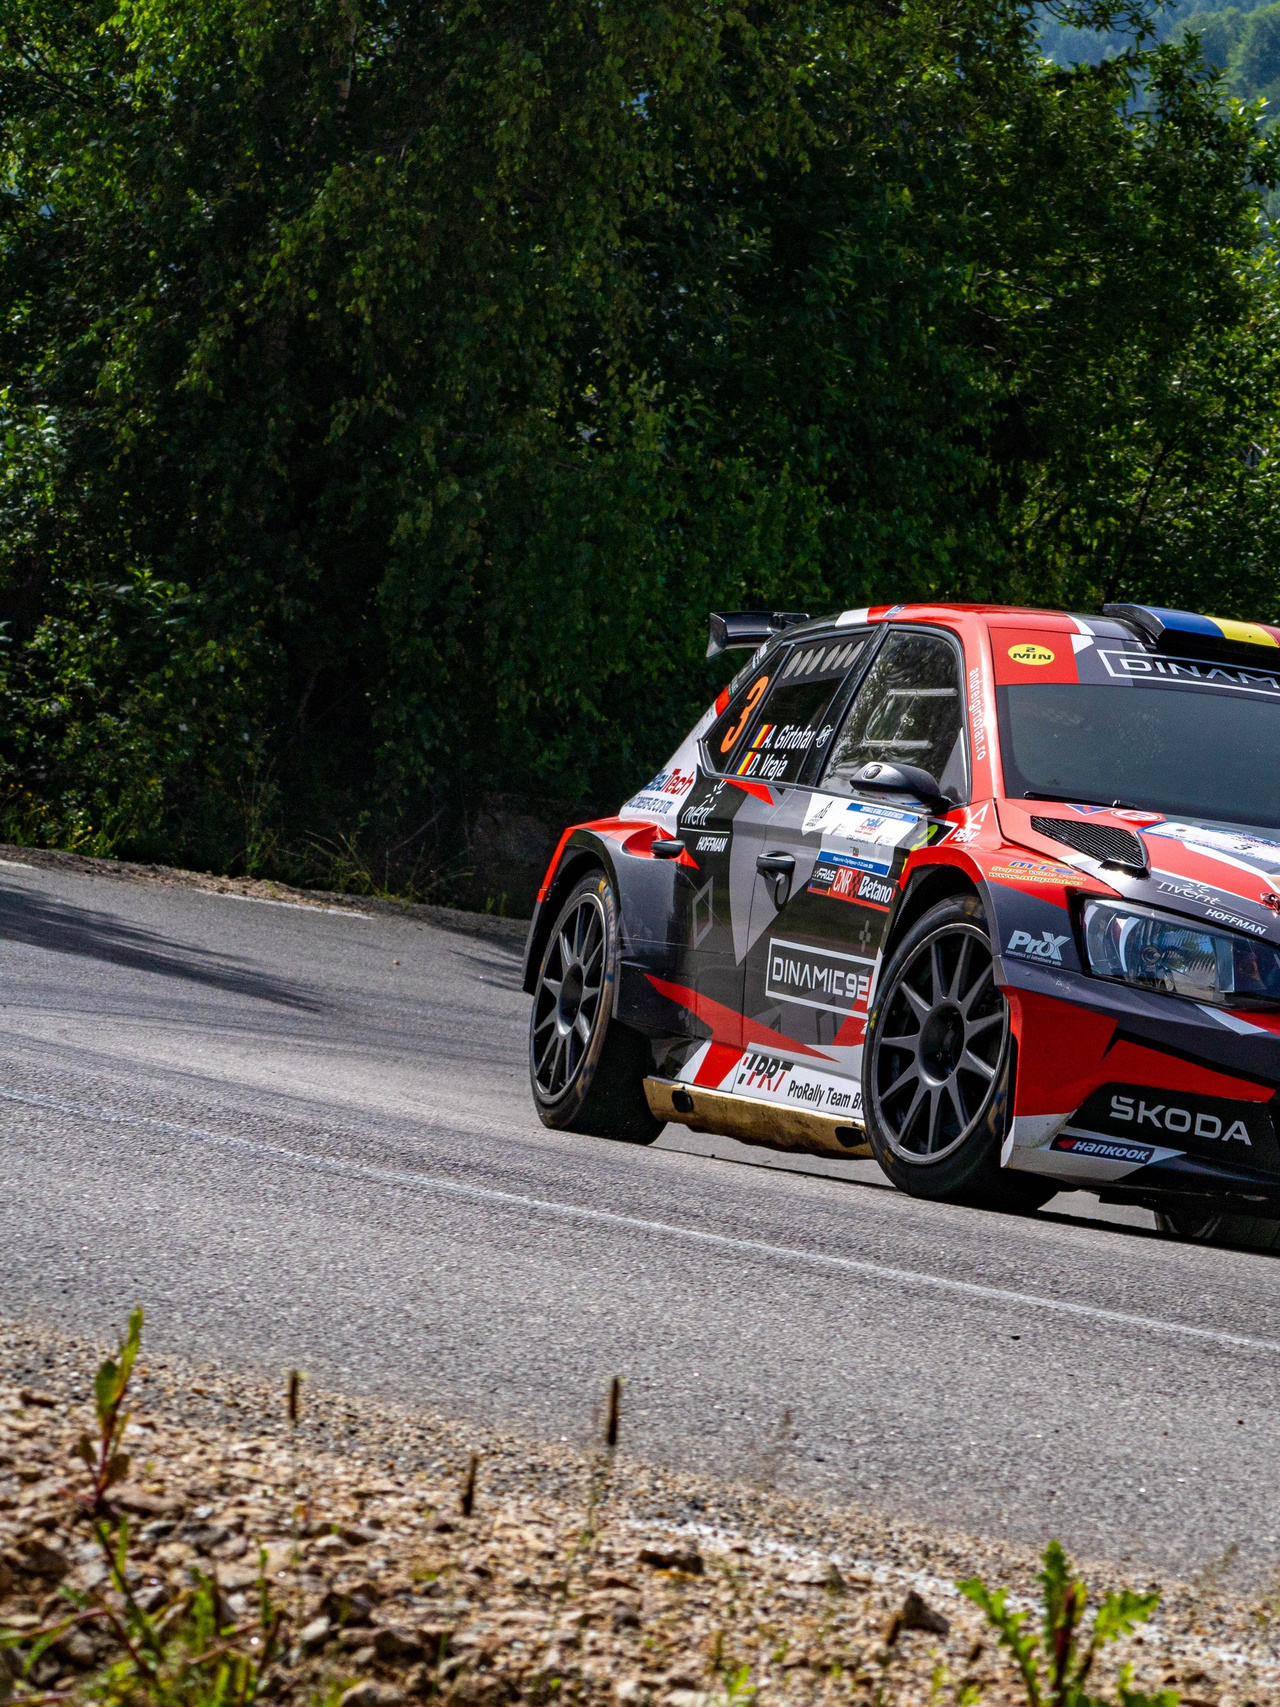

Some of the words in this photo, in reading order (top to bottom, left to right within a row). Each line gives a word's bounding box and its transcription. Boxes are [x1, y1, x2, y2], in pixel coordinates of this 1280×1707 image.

[720, 676, 769, 753] 3
[969, 667, 987, 760] andreigirtofan.ro
[760, 725, 777, 749] A.
[745, 754, 761, 776] D.
[759, 754, 788, 780] Vraja
[696, 836, 728, 852] HOFFMAN
[950, 828, 981, 843] PEAK
[832, 868, 853, 894] CNR
[858, 876, 893, 904] Betano
[1205, 908, 1267, 935] HOFFMAN
[1007, 930, 1071, 961] ProX
[772, 957, 870, 1002] DINAMIC92
[787, 1080, 825, 1107] ProRally
[826, 1087, 851, 1108] Team
